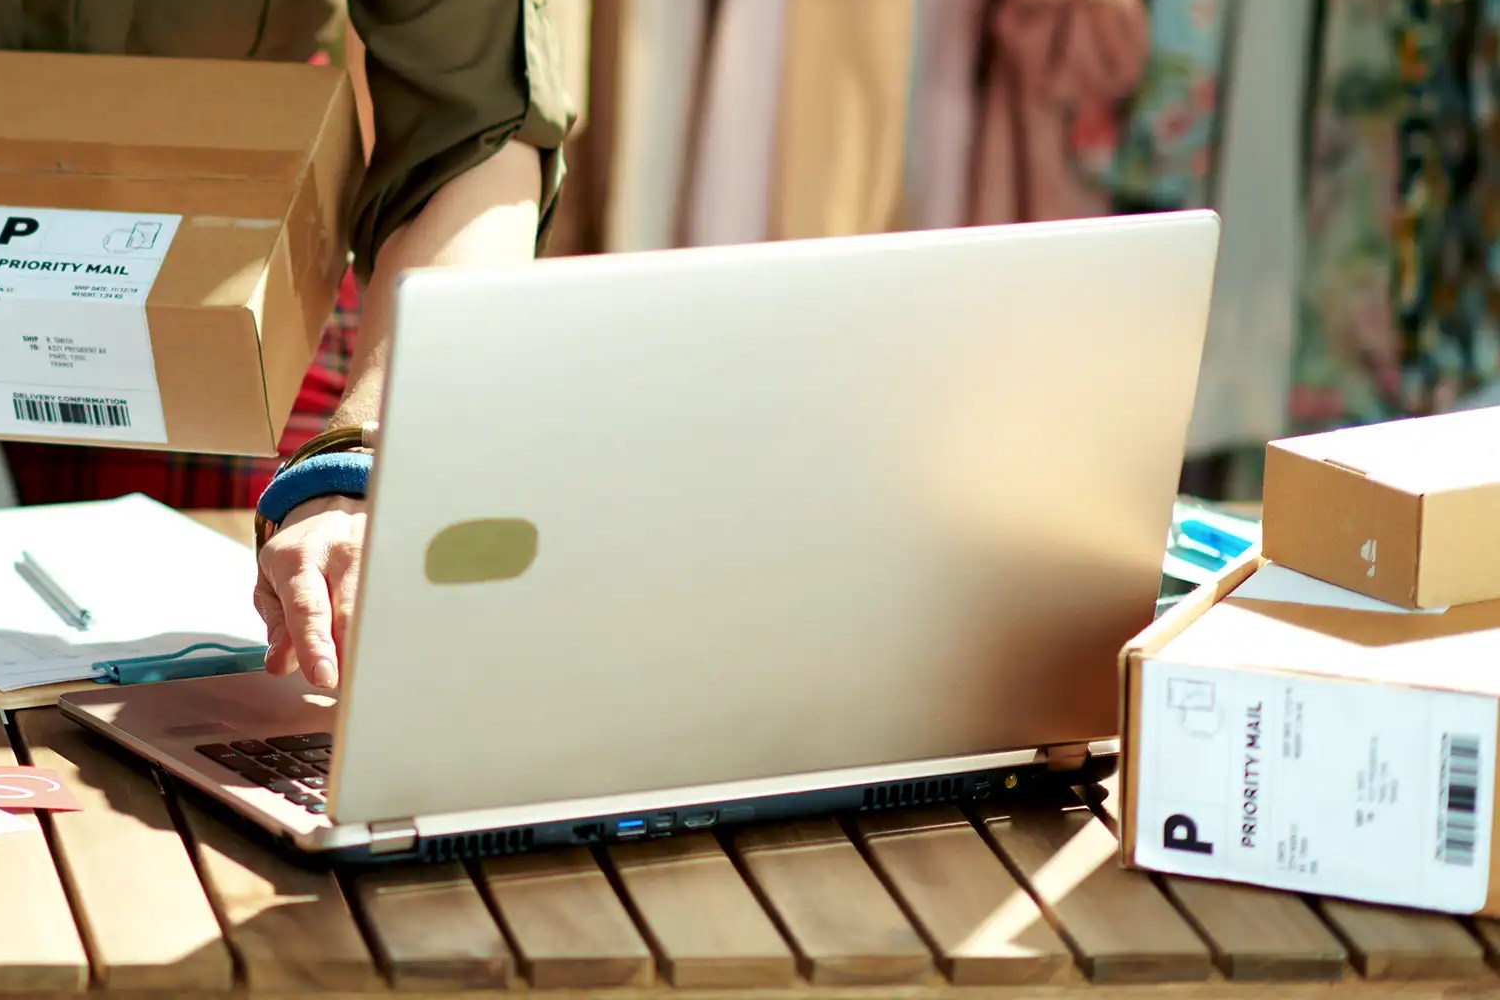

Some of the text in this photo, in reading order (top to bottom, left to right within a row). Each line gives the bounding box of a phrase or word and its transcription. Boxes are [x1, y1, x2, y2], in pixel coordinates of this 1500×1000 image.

[85, 263, 129, 276] MAIL
[12, 391, 128, 406] DELIVERY CONFIRMATION
[1240, 701, 1263, 848] PRIORITY MAIL
[1163, 812, 1214, 855] P
